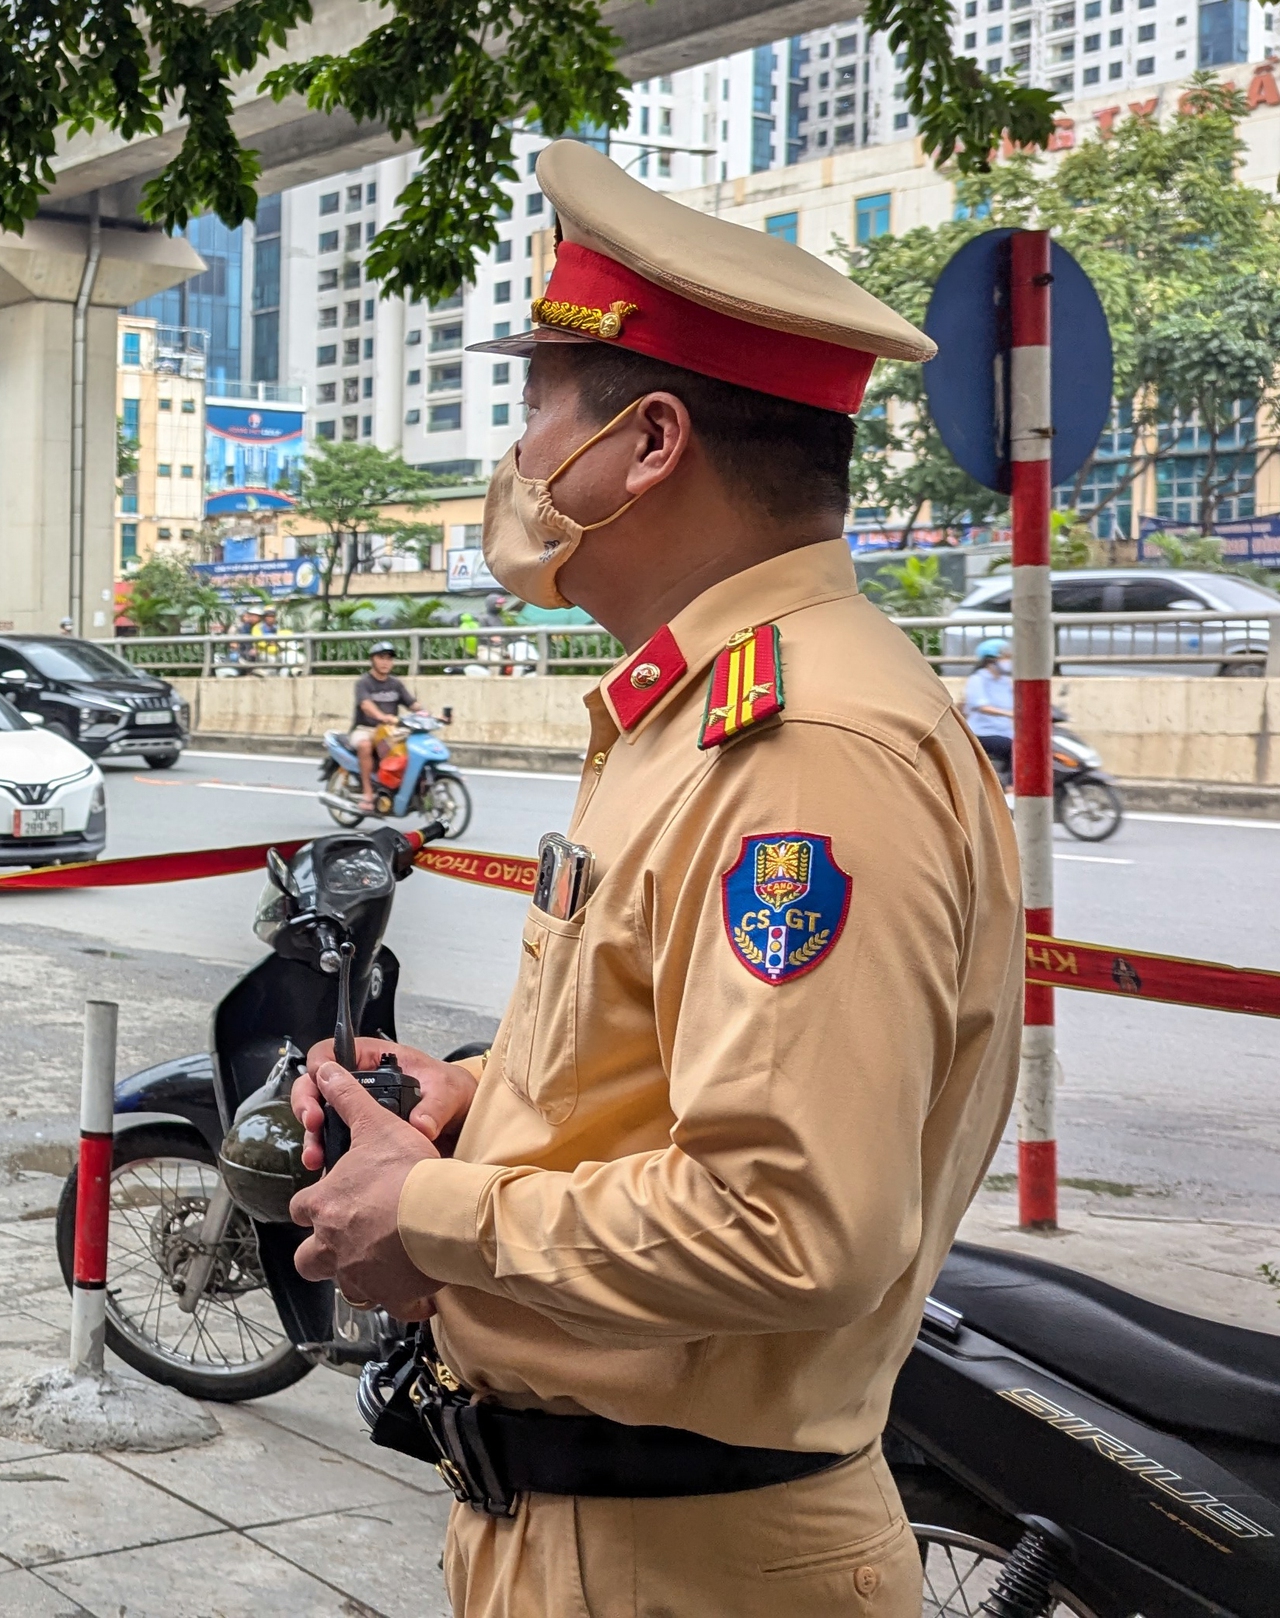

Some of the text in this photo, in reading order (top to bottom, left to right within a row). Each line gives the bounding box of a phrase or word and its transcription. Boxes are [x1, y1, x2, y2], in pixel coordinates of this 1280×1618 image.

[415, 851, 538, 886] GIAO THÔN
[767, 881, 794, 892] CAND
[741, 908, 822, 933] CS GT
[1026, 945, 1078, 975] KH
[995, 1388, 1275, 1539] SIRIUS
